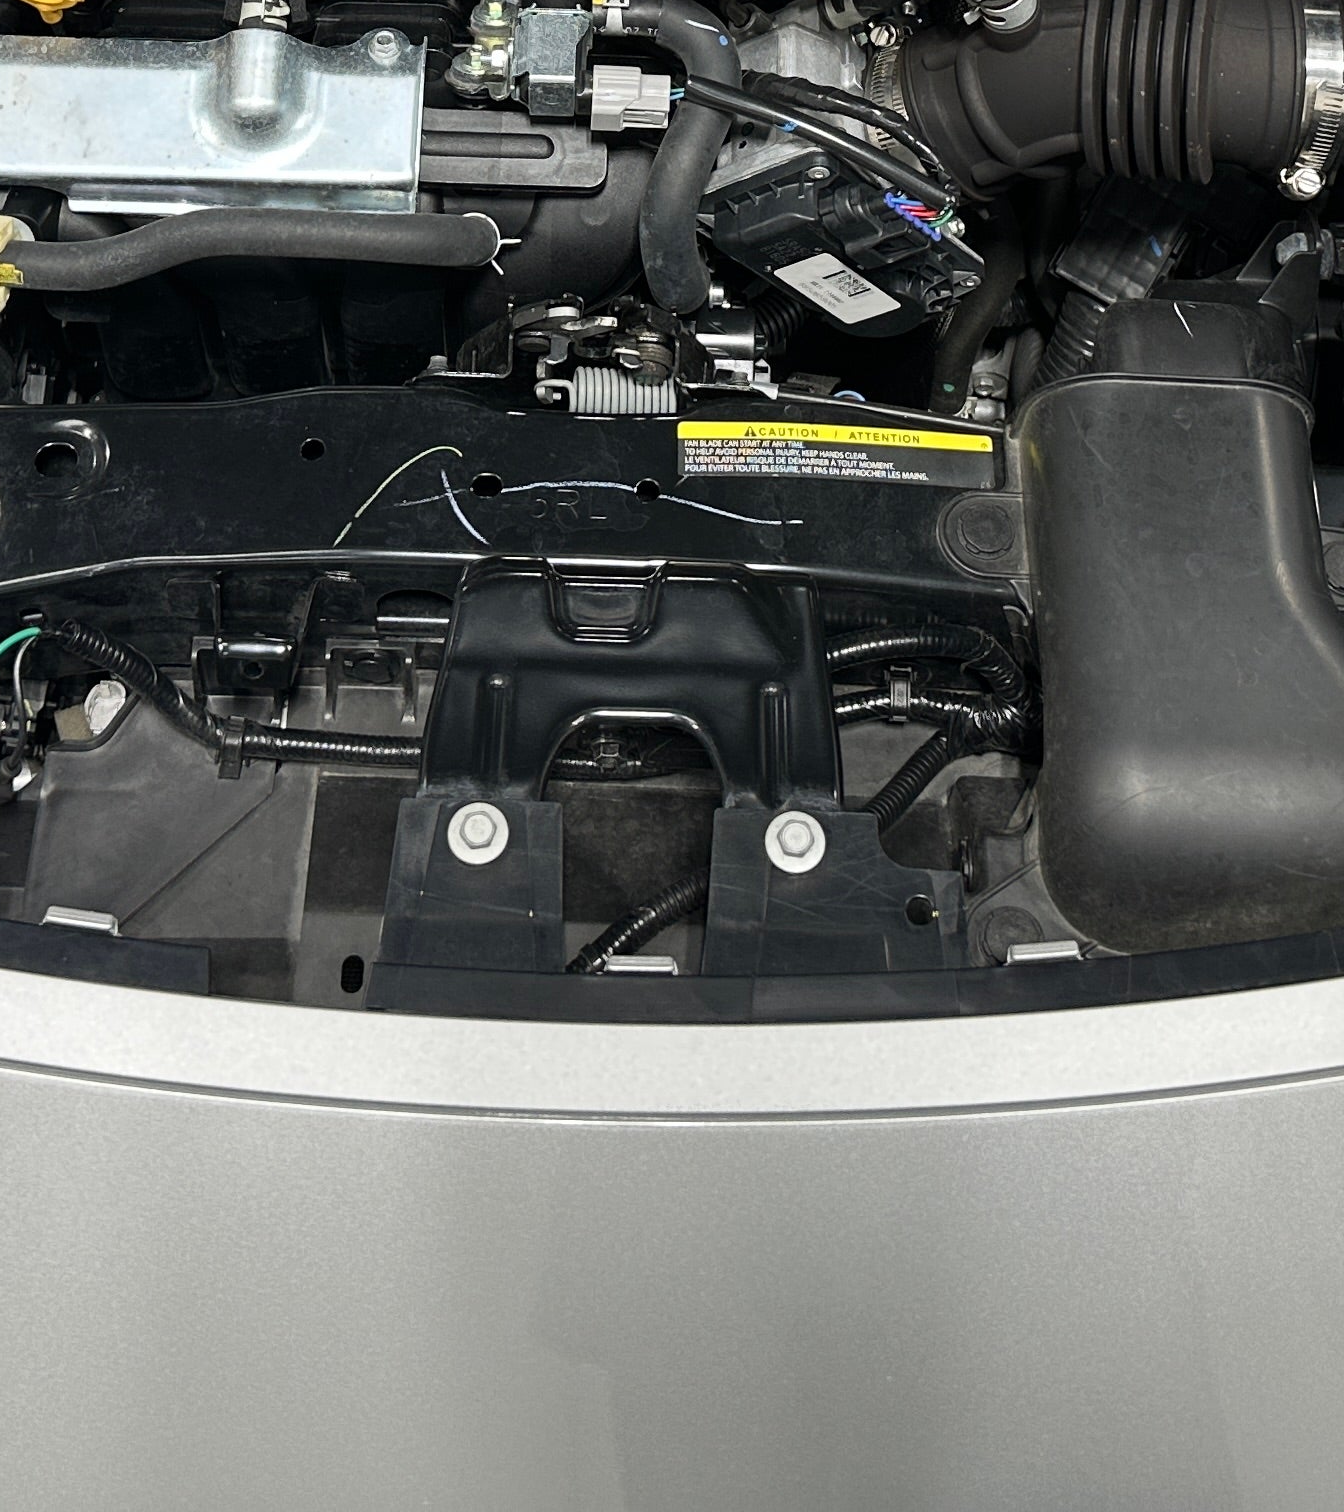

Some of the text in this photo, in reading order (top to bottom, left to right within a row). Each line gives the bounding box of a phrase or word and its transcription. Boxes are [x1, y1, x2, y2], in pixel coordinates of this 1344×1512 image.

[758, 426, 820, 438] CAUTION
[848, 431, 921, 444] ATTENTION
[684, 440, 698, 448] FAN
[699, 440, 722, 448] BLADE
[723, 440, 739, 448] CAN
[740, 440, 761, 449] START
[761, 441, 771, 449] AT
[772, 441, 787, 449] ANY
[685, 448, 695, 456] TO
[696, 448, 714, 456] HELP
[714, 448, 737, 456] AVOID
[738, 448, 774, 457] PERSONAL
[801, 450, 818, 458] KEEP
[819, 451, 844, 459] HANDS
[684, 456, 694, 464] LE
[695, 456, 745, 465] VENTILATEUR
[746, 457, 774, 465] RISQUE
[776, 457, 787, 465] DE
[837, 460, 858, 468] TOUT
[684, 464, 707, 473] POUR
[735, 465, 760, 473] TOUTE
[801, 466, 813, 474] NE
[813, 467, 828, 475] PAS
[829, 468, 840, 476] EN
[840, 468, 887, 478] APPROCHER
[888, 470, 901, 479] LES
